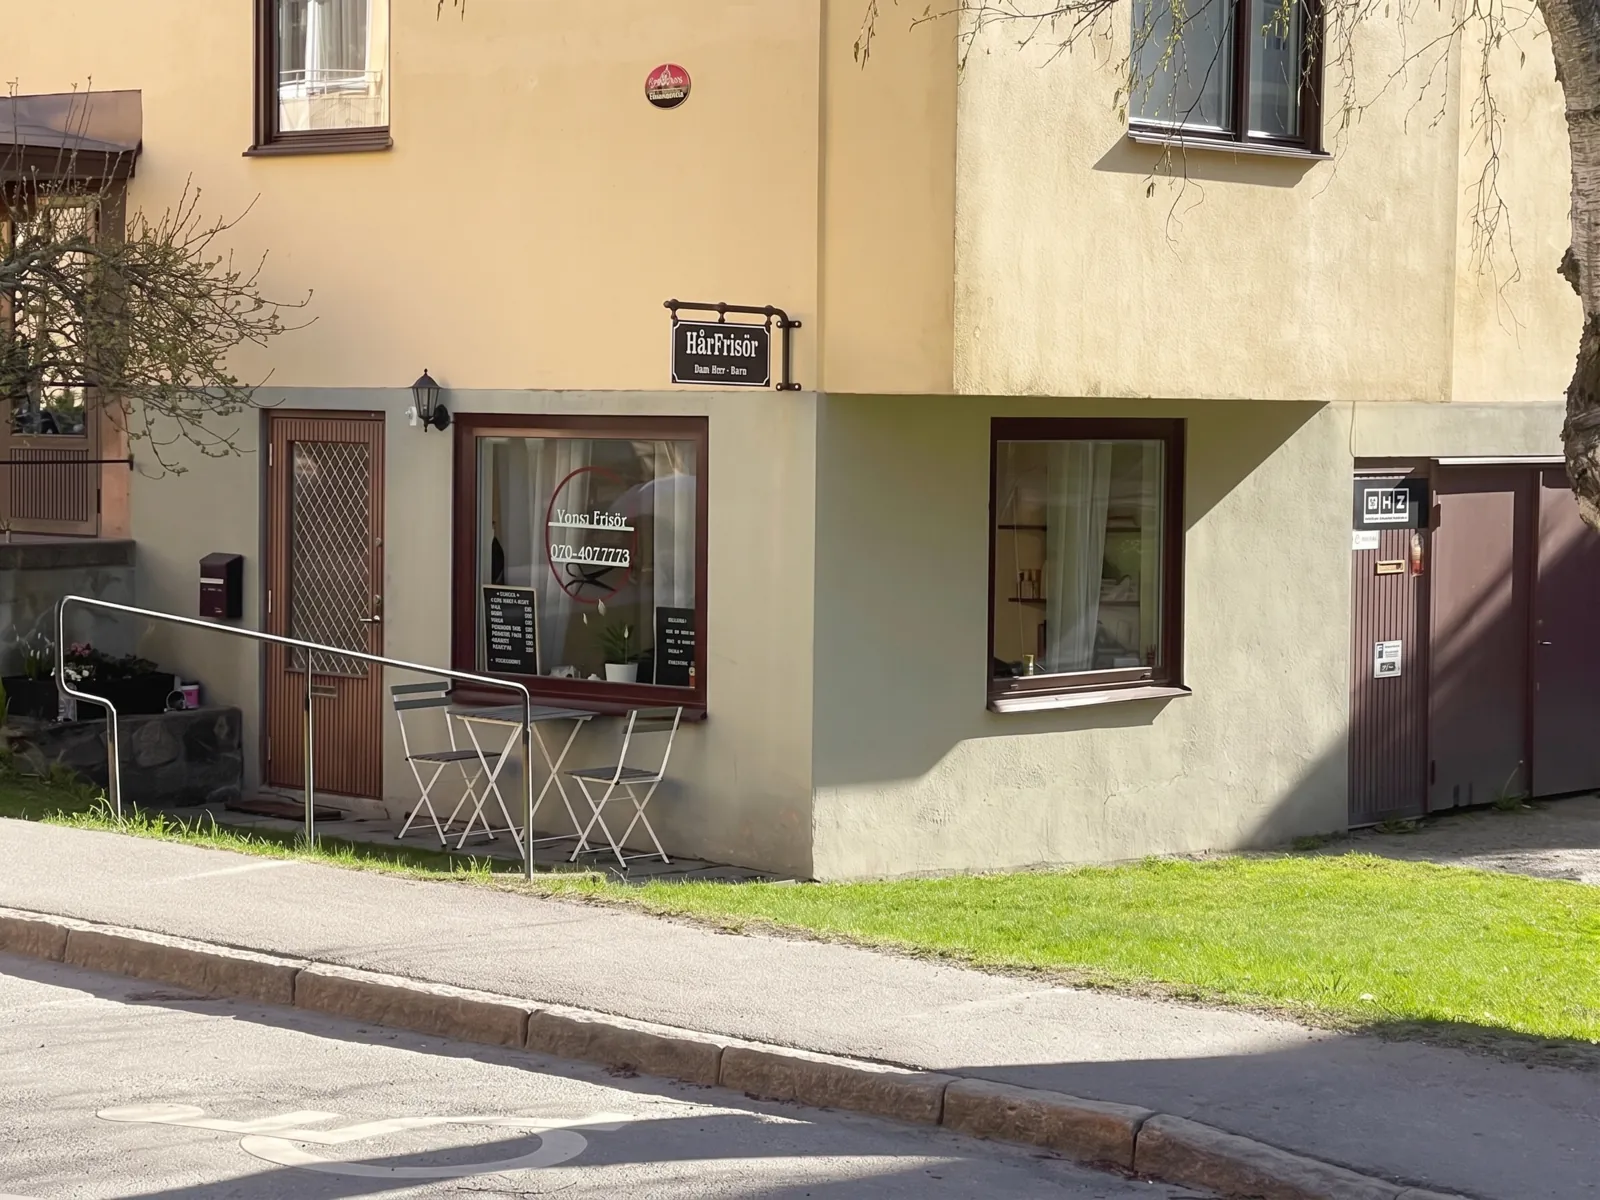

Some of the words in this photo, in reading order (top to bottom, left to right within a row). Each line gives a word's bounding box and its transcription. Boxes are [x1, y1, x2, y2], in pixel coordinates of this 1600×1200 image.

[686, 329, 758, 357] HårFrisör
[694, 364, 710, 374] Dam
[730, 366, 747, 376] Barn
[593, 511, 627, 528] Frisör
[551, 544, 631, 564] 070-4077773
